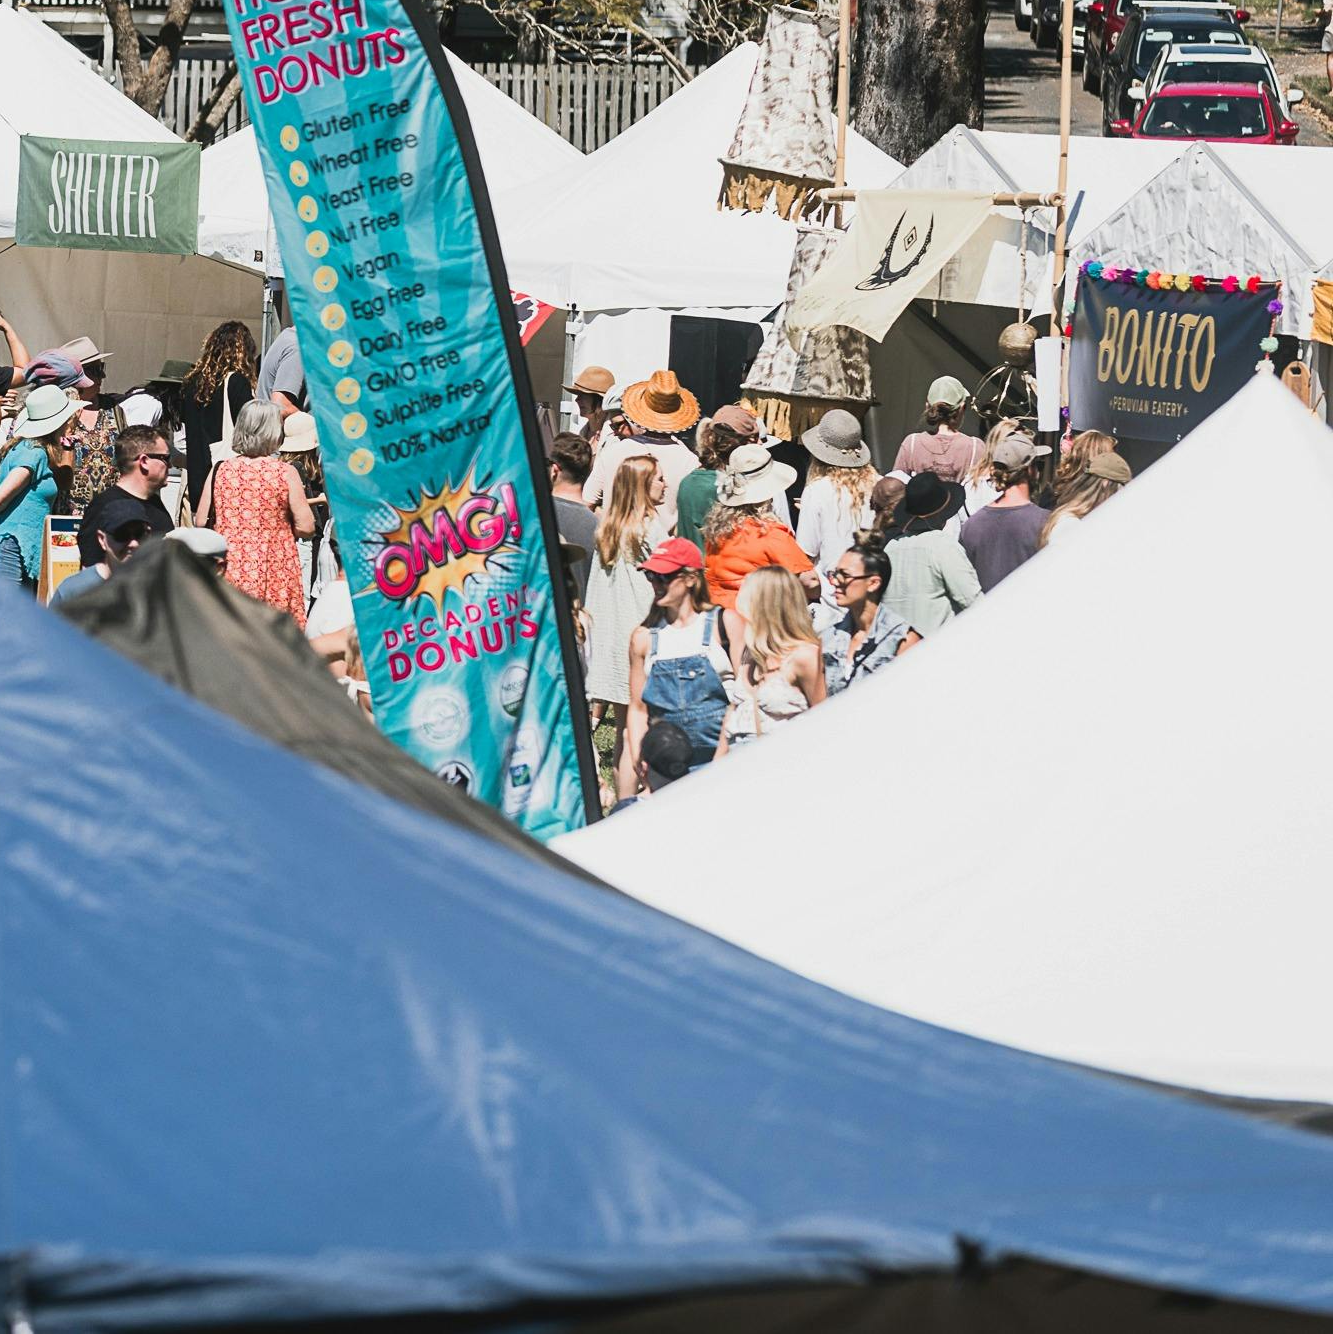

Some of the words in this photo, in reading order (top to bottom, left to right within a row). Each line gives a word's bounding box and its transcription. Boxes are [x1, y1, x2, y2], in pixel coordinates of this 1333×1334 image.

[254, 28, 407, 104] DONUTS
[301, 110, 364, 143] Gluten
[368, 98, 411, 122] Free
[309, 143, 369, 176] Wheat
[374, 133, 418, 158] Free
[48, 150, 160, 238] SHELTER
[319, 181, 365, 212] Yeast
[368, 172, 414, 197] Free
[329, 222, 357, 247] Nut
[360, 211, 400, 237] Free
[342, 251, 401, 282] Vegan
[350, 296, 386, 321] Egg
[387, 282, 426, 308] Free
[359, 329, 404, 357] Dairy
[406, 316, 447, 341] Free
[1098, 306, 1216, 393] BONITO
[366, 362, 417, 392] GMO
[420, 349, 461, 375] Free
[373, 390, 443, 429] Sulphite
[445, 378, 486, 404] Free
[1113, 396, 1149, 413] PERUVIAN
[1152, 400, 1183, 417] EATERY
[379, 432, 428, 464] 100%
[428, 408, 495, 448] Natural
[374, 481, 523, 601] OMG!
[383, 584, 529, 651] DECADENT
[388, 609, 540, 682] DONUTS
